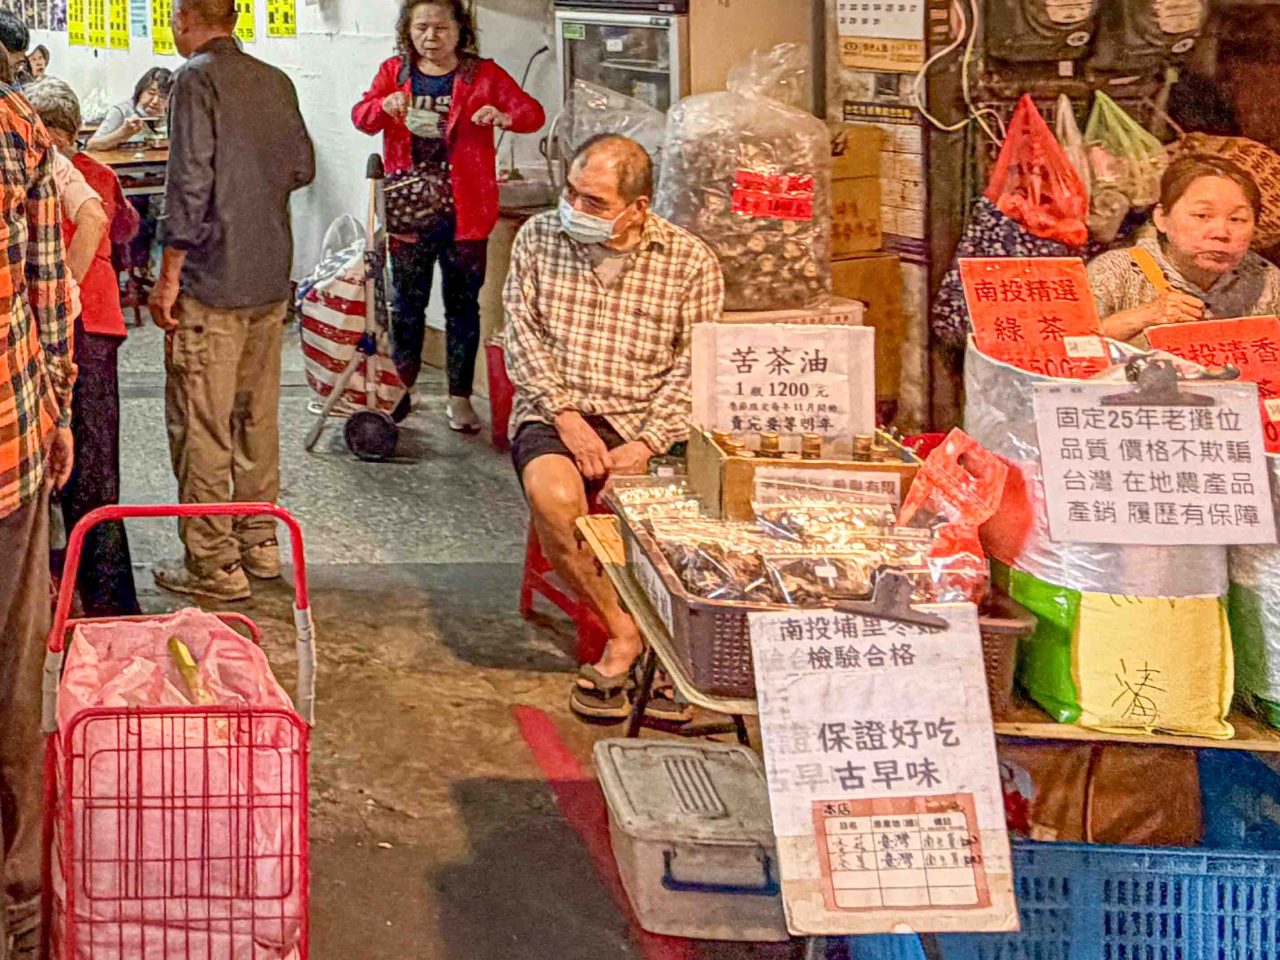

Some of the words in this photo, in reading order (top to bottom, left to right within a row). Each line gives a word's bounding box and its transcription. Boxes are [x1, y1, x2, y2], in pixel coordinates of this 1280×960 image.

[974, 278, 1080, 302] 南投精選
[993, 314, 1066, 342] 綠茶
[729, 346, 829, 376] 苦茶油
[736, 381, 745, 396] 1
[768, 381, 810, 398] 1200
[1056, 406, 1243, 432] 固定25年老攤位
[1060, 438, 1110, 461] 品質
[1119, 439, 1253, 465] 價格不欺騙
[1063, 469, 1114, 492] 台灣
[1122, 470, 1256, 496] 在地農產品
[1067, 500, 1117, 524] 產銷
[1127, 501, 1261, 527] 履歷有保障
[807, 642, 916, 670] 檢驗合格
[817, 716, 961, 754] 保證好吃
[834, 757, 942, 791] 古早味
